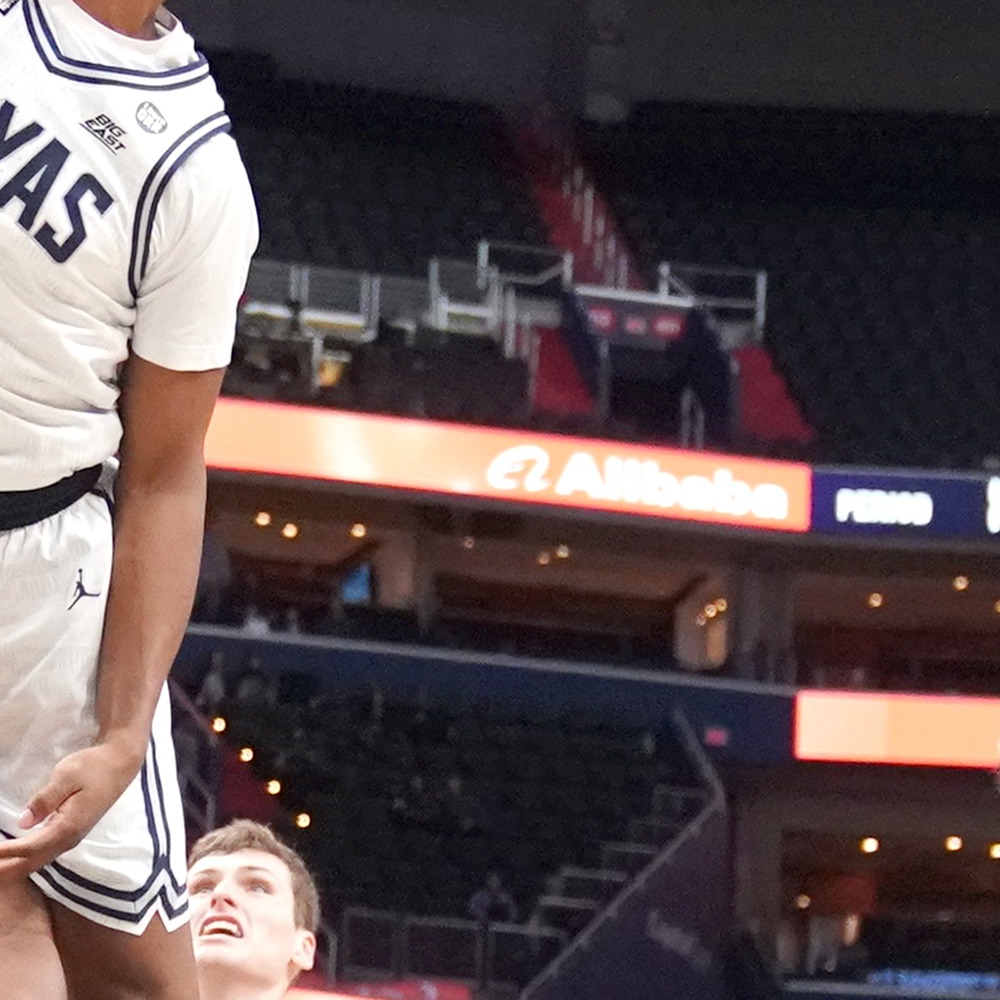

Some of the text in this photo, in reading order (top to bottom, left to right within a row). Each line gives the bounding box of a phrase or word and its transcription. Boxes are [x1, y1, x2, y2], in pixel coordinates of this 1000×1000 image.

[84, 119, 127, 150] EAST
[95, 113, 127, 138] BIG
[555, 452, 788, 520] Alibaba
